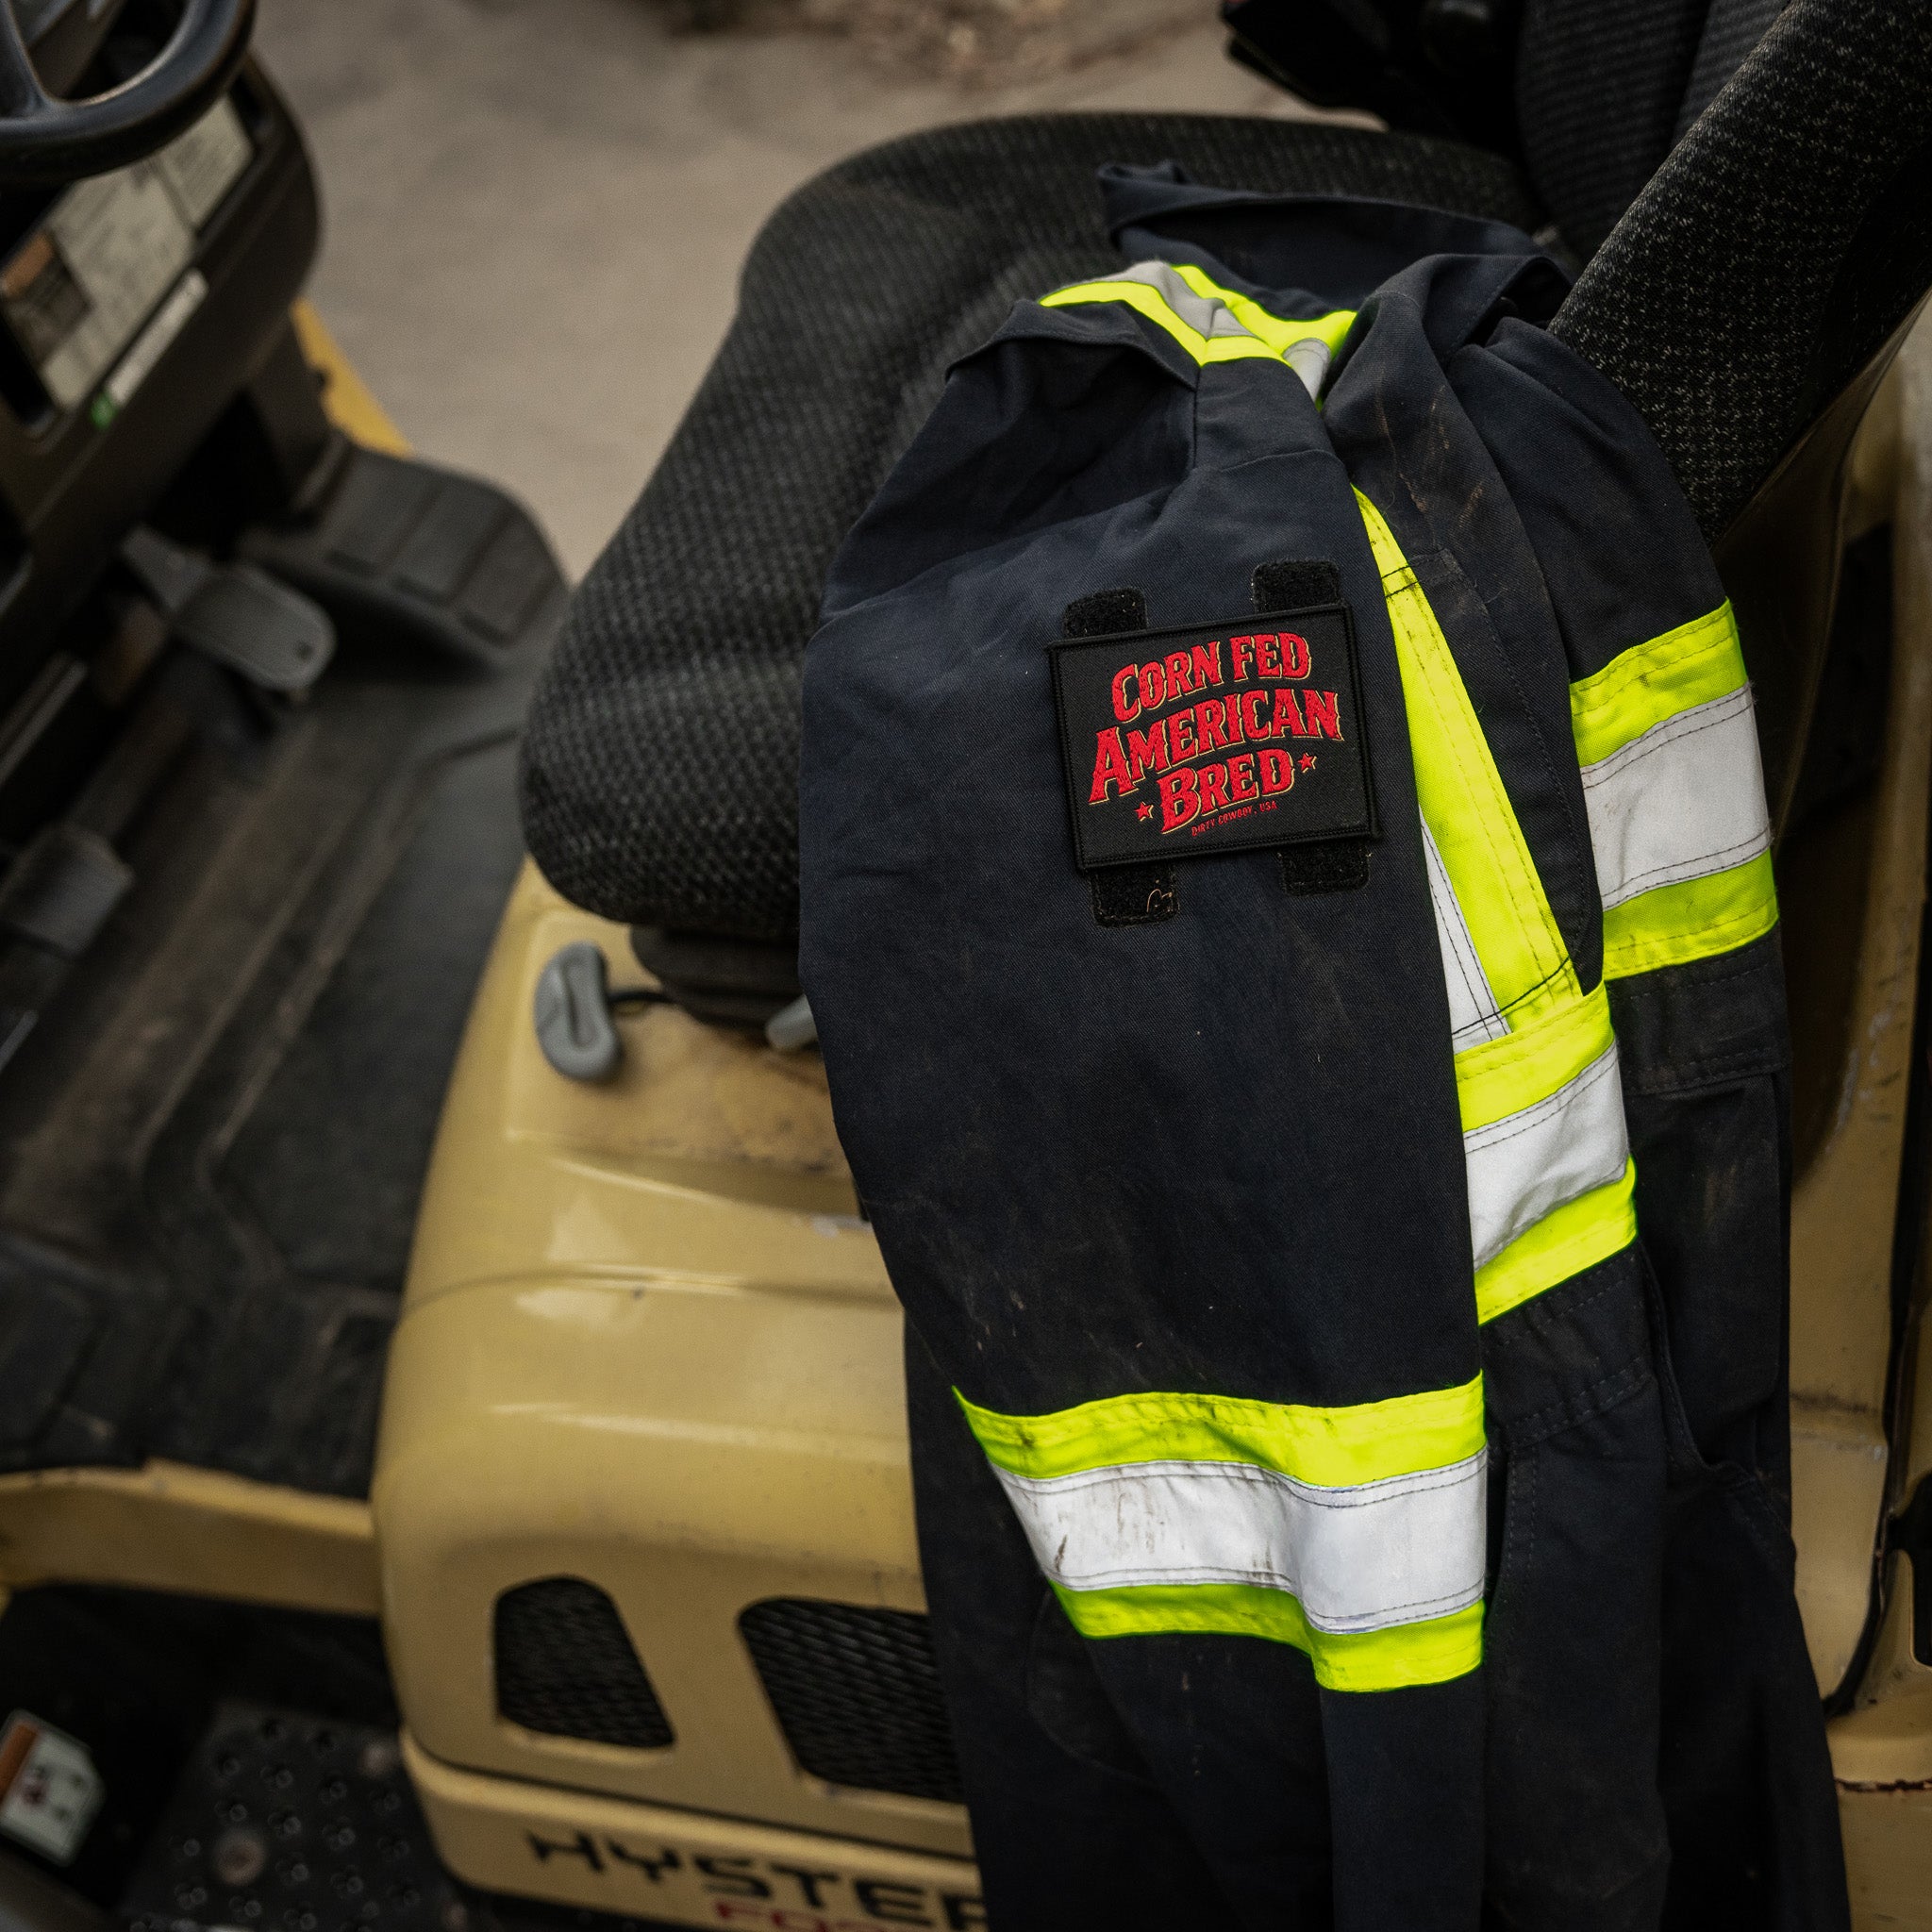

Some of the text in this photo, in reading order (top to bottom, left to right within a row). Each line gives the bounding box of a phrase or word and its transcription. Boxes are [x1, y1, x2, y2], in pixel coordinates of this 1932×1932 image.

[1110, 632, 1312, 724] CORN FED
[1088, 689, 1345, 805] AMERICAN
[1157, 748, 1295, 834] BRED
[1191, 818, 1216, 837] DIRTY
[1258, 800, 1278, 812] USA
